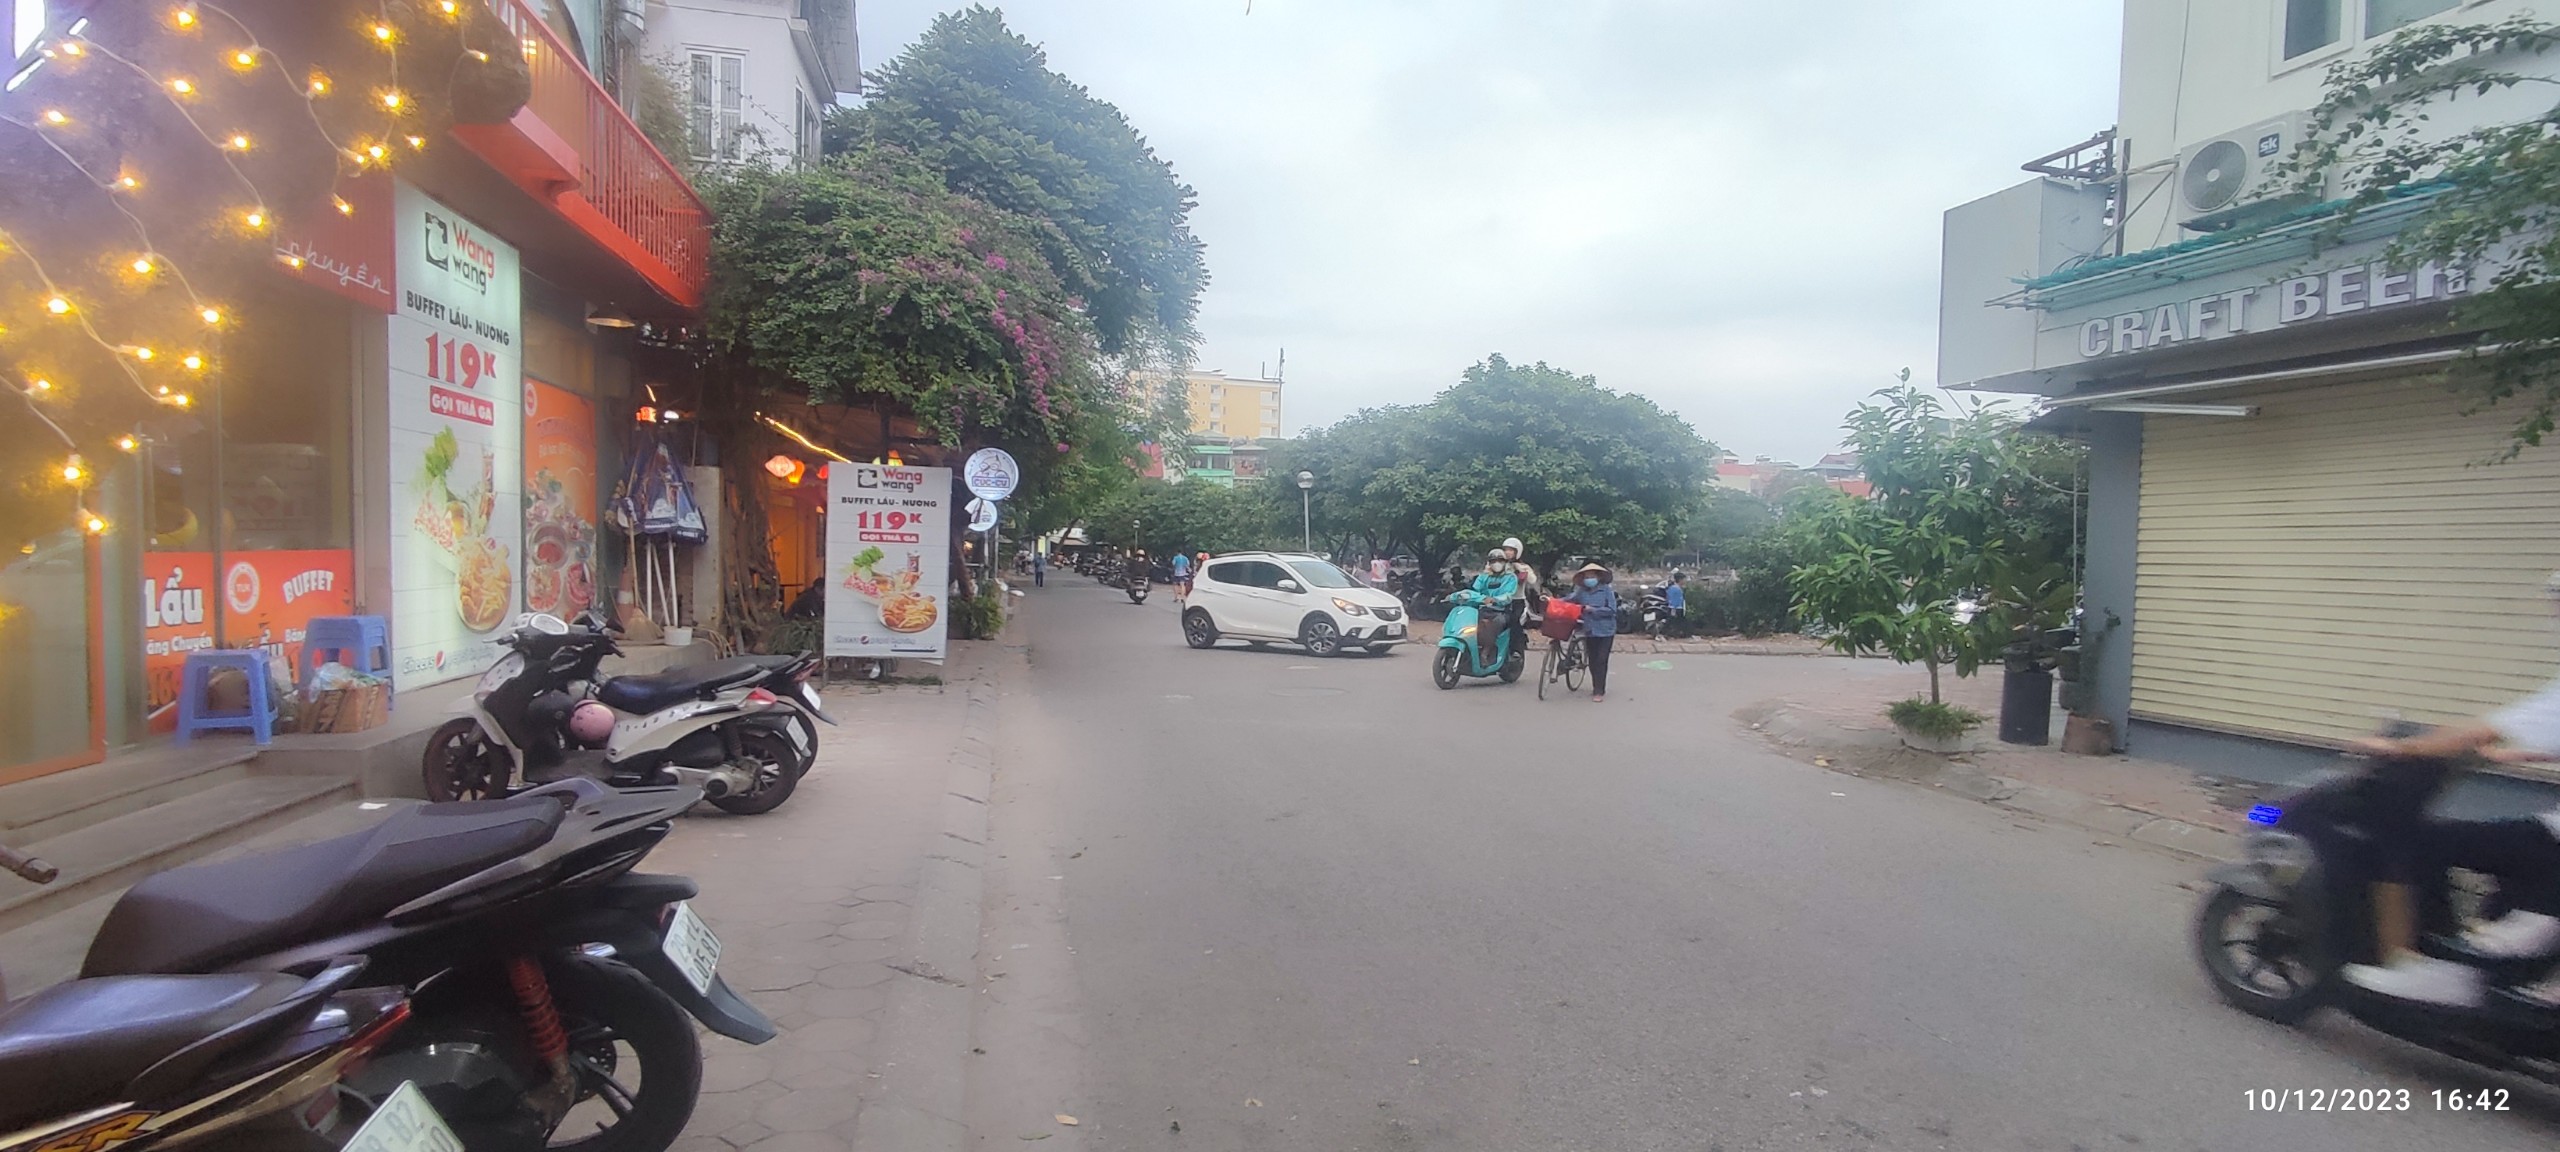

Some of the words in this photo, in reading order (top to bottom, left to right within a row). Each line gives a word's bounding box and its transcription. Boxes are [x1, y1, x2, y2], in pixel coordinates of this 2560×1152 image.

[453, 222, 495, 278] Wang
[452, 256, 487, 295] wang
[406, 290, 445, 321] BUFFET
[2079, 287, 2254, 357] CRAFT
[432, 393, 453, 413] GỌI
[478, 405, 493, 422] GA
[881, 480, 914, 493] wang
[882, 467, 922, 485] Wang
[841, 496, 874, 505] BUFFET
[282, 569, 334, 604] BUFFET
